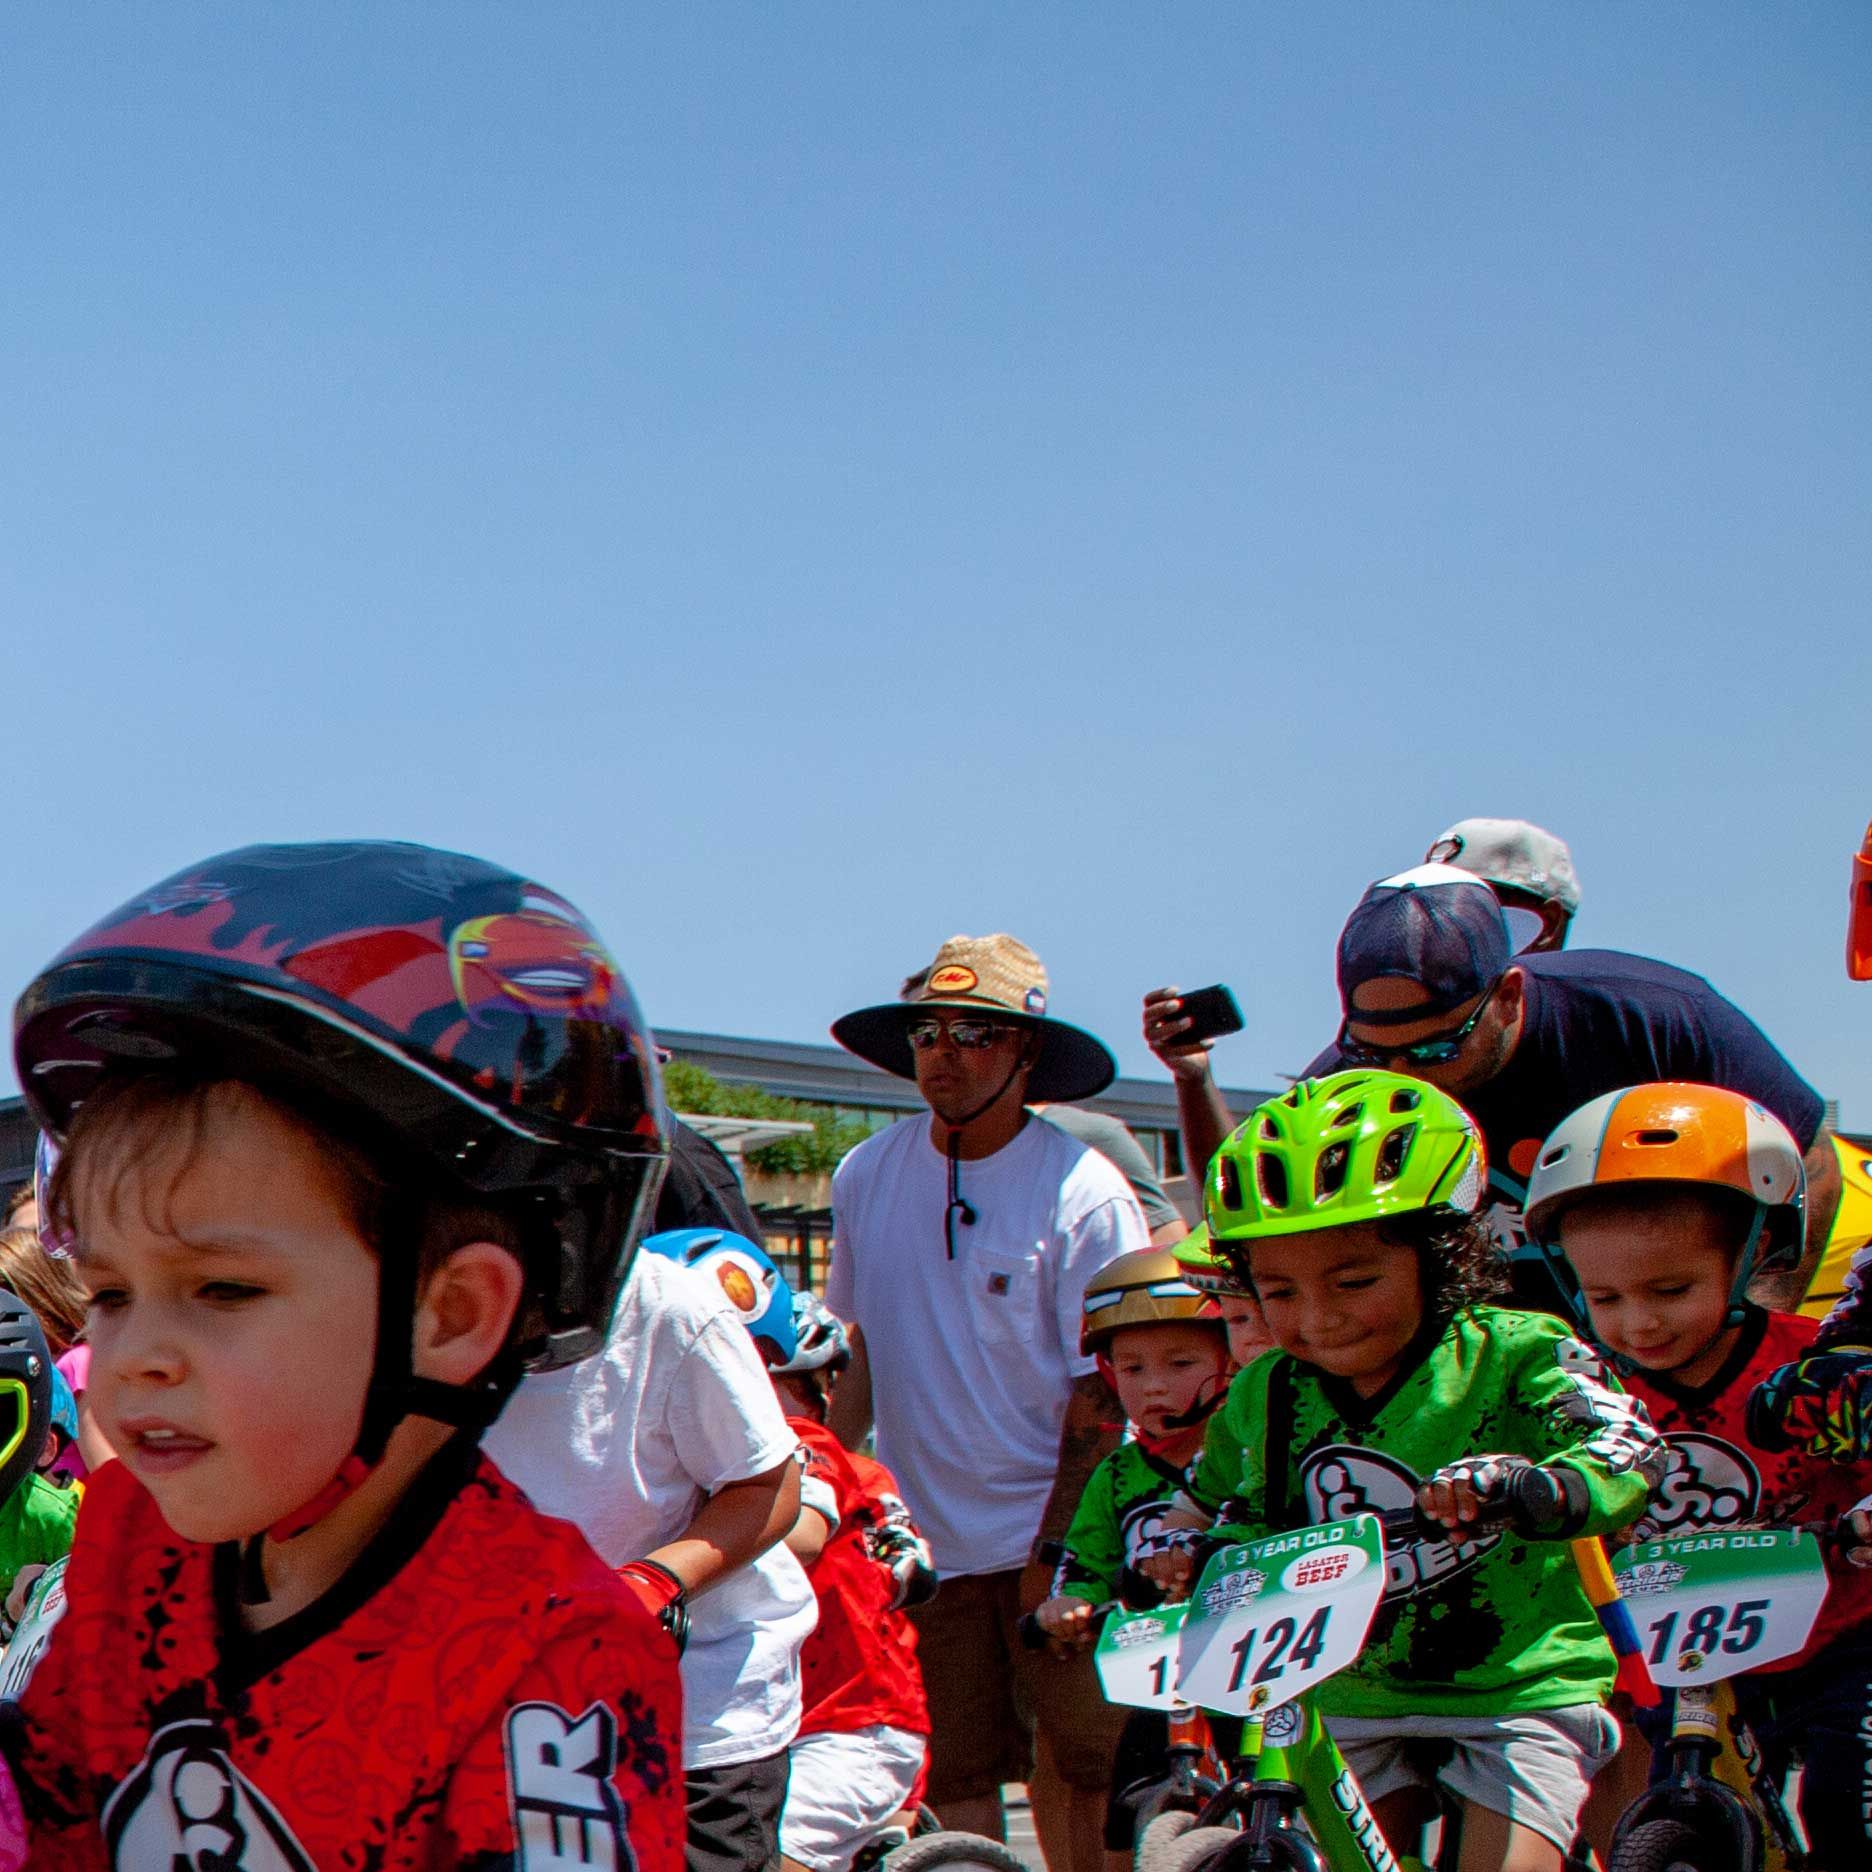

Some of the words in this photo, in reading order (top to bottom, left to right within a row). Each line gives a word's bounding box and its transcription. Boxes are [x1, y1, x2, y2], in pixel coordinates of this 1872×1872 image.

[1235, 1549, 1249, 1563] 3
[1254, 1537, 1301, 1557] YEAR
[1303, 1527, 1345, 1548] OLD
[1298, 1553, 1348, 1570] LASATER
[1648, 1540, 1661, 1557] 3
[1669, 1538, 1727, 1555] YEAR
[1729, 1534, 1776, 1549] OLD
[1295, 1563, 1347, 1586] BEEF
[1227, 1604, 1332, 1693] 124
[1648, 1600, 1771, 1666] 185
[1149, 1655, 1182, 1696] 1
